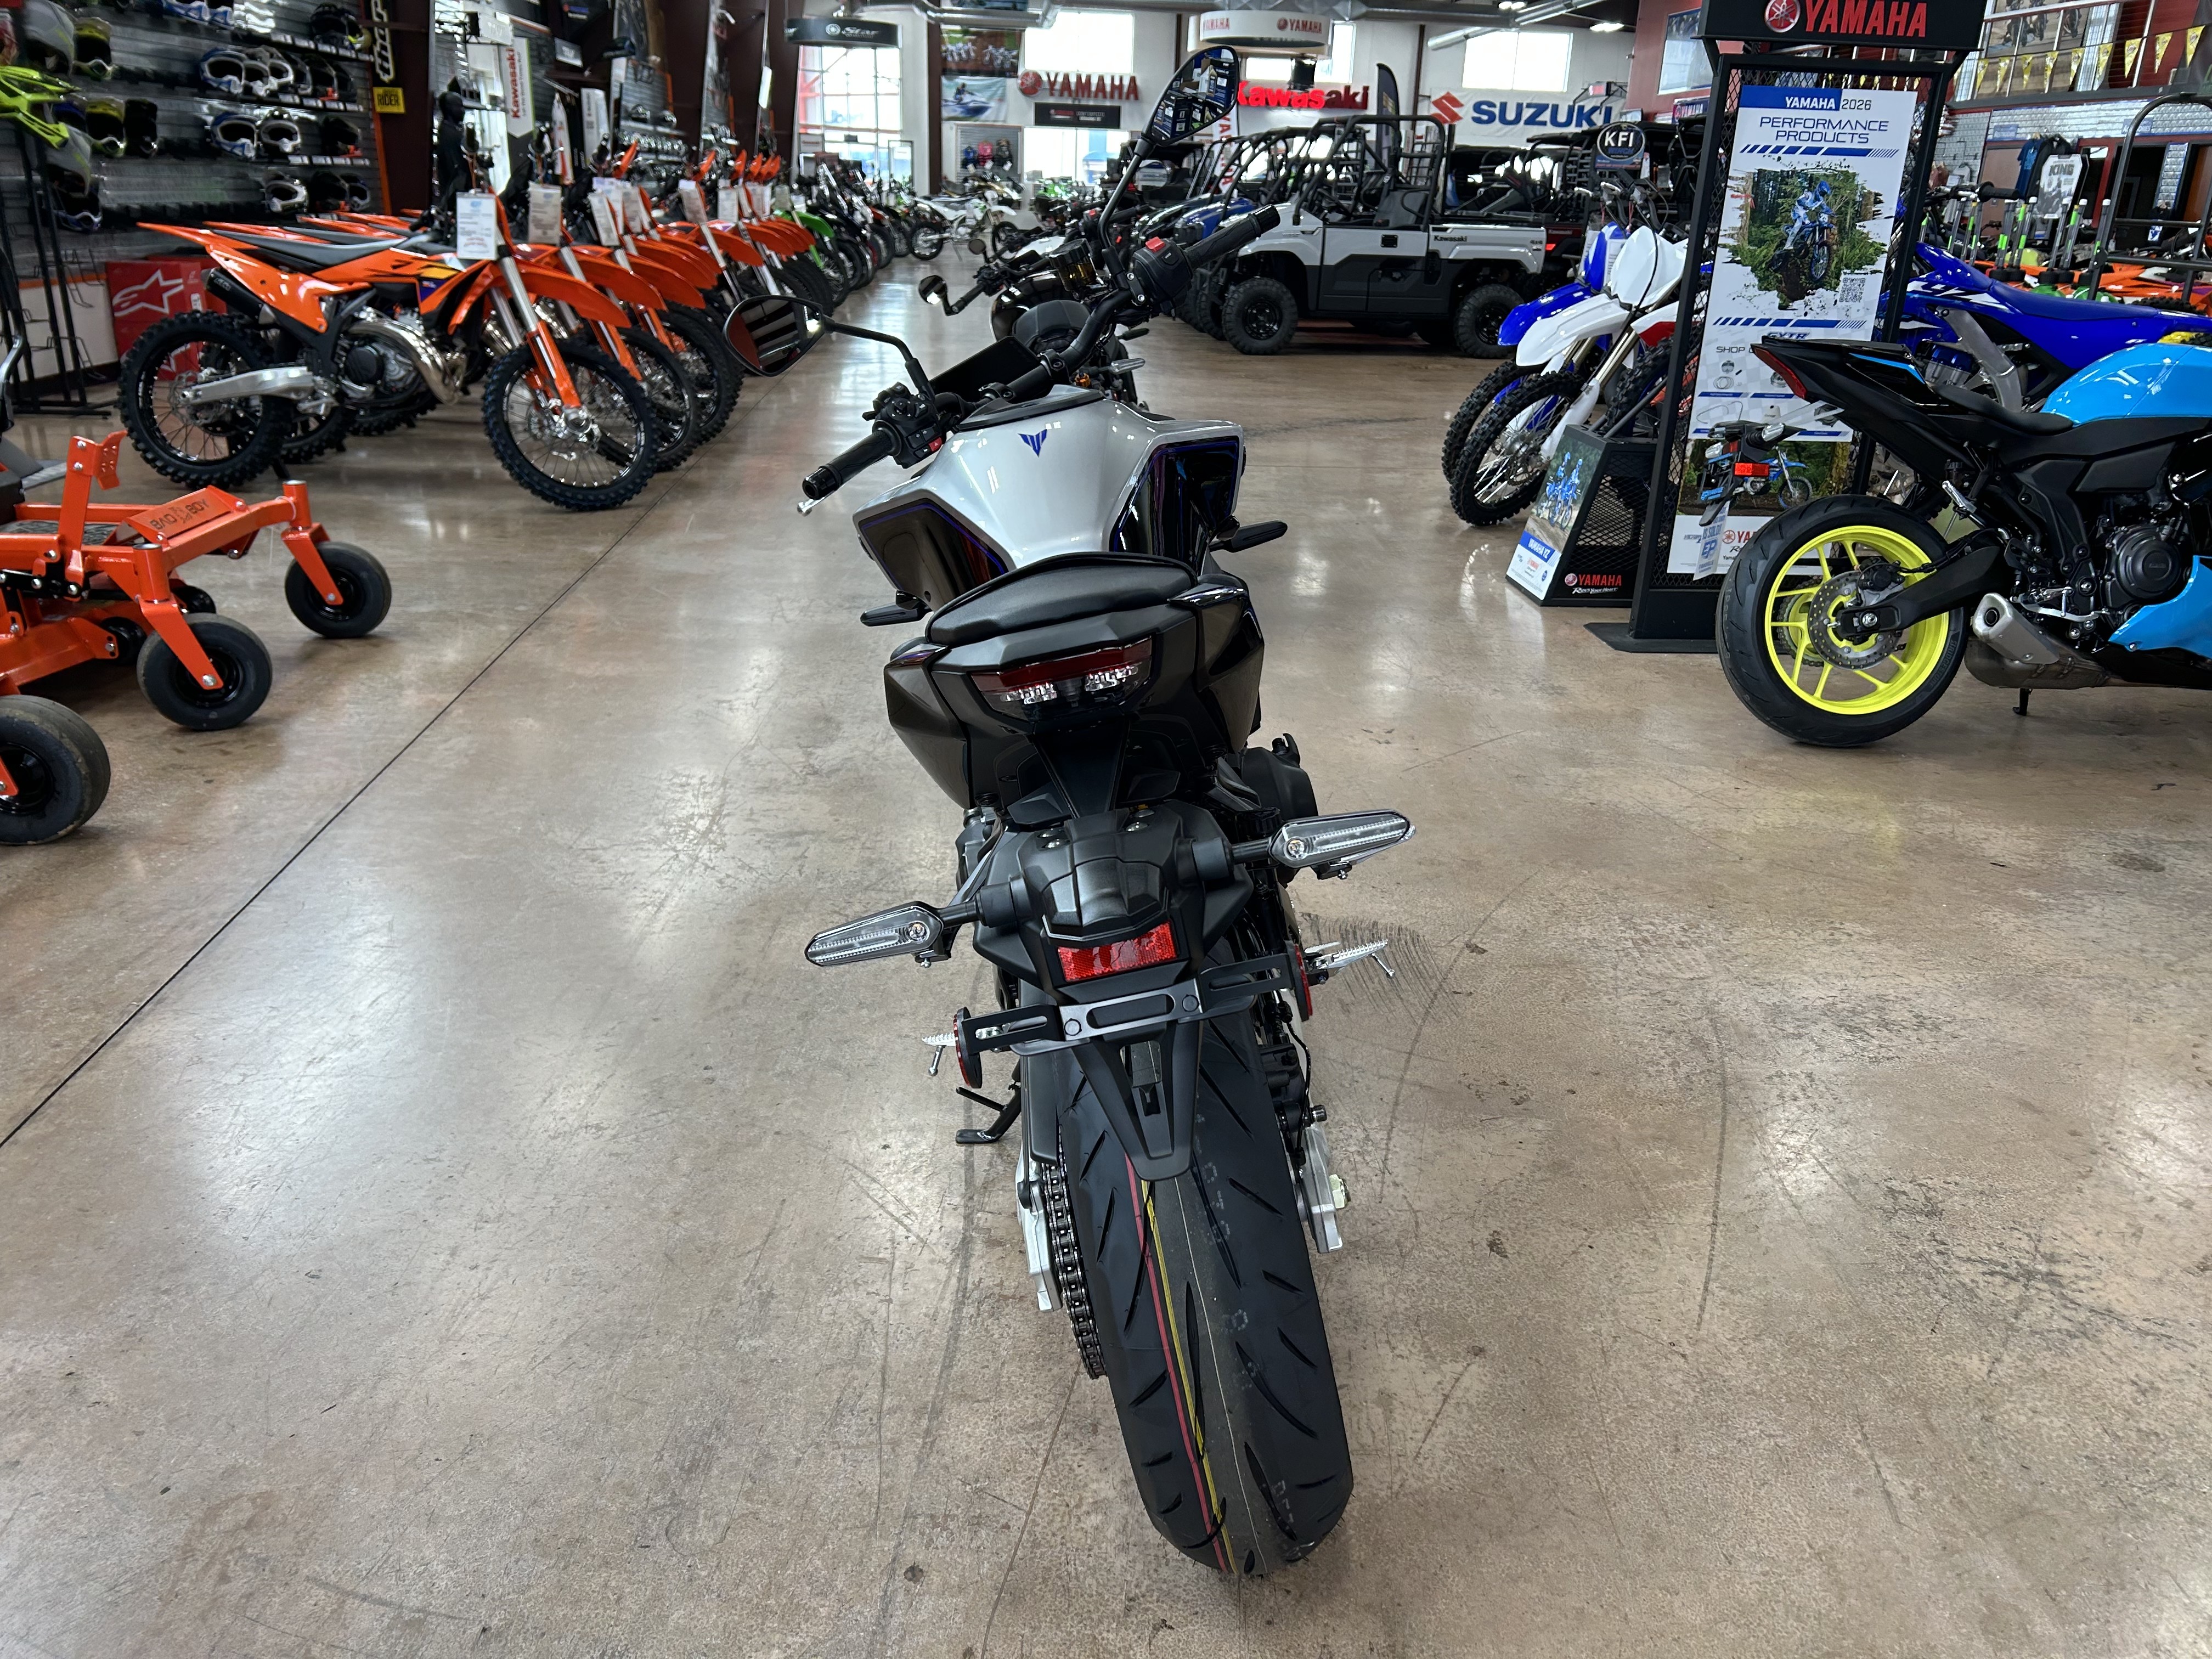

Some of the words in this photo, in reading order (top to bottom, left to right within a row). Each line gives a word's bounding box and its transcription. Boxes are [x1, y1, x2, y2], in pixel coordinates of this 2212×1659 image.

[1805, 0, 1927, 37] YAMAHA
[1289, 19, 1322, 34] YAMAHA
[506, 47, 520, 119] Kawasaki
[1046, 71, 1139, 100] YAMAHA
[377, 94, 401, 106] RIDER
[1785, 96, 1836, 110] YAMAHA
[1841, 99, 1872, 110] 2026
[1471, 100, 1612, 128] SUZUKI
[1759, 116, 1889, 132] PERFORMANCE
[1604, 131, 1634, 147] KFI
[1775, 130, 1870, 144] PRODUCTS
[2049, 164, 2075, 176] KING
[1716, 346, 1746, 354] SHOP
[1578, 573, 1622, 586] YAMAHA
